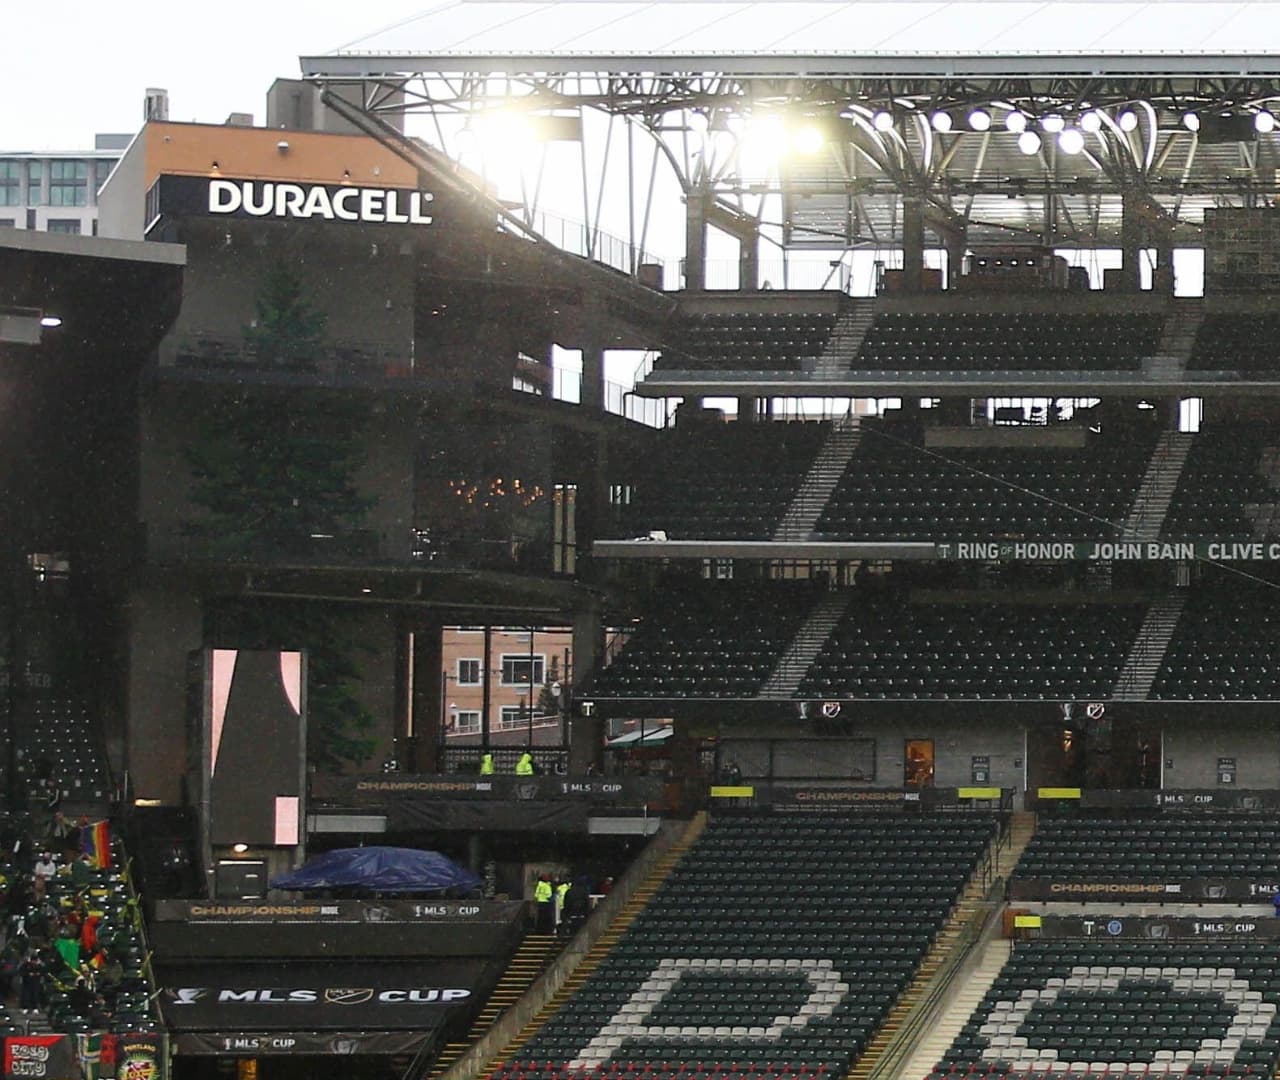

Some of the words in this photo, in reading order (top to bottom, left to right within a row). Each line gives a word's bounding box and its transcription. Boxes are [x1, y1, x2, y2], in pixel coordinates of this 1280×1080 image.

[958, 543, 998, 559] RING
[1014, 543, 1075, 559] HONOR
[1089, 543, 1141, 559] JOHN
[1148, 543, 1194, 559] BAIN
[1208, 543, 1263, 560] CLIVE
[571, 784, 591, 792] MLS
[602, 784, 621, 792] CUP
[1051, 884, 1164, 893] CHAMPIONSHIP
[1259, 885, 1279, 893] MLS
[190, 905, 320, 915] CHAMPIONSHIP
[425, 907, 447, 915] MLS
[459, 907, 480, 915] CUP
[1203, 923, 1223, 932] MLS
[1236, 923, 1255, 932] CUP
[218, 989, 318, 1002] MLS
[378, 989, 472, 1002] CUP
[235, 1039, 259, 1048] MLS
[273, 1039, 295, 1049] CUP
